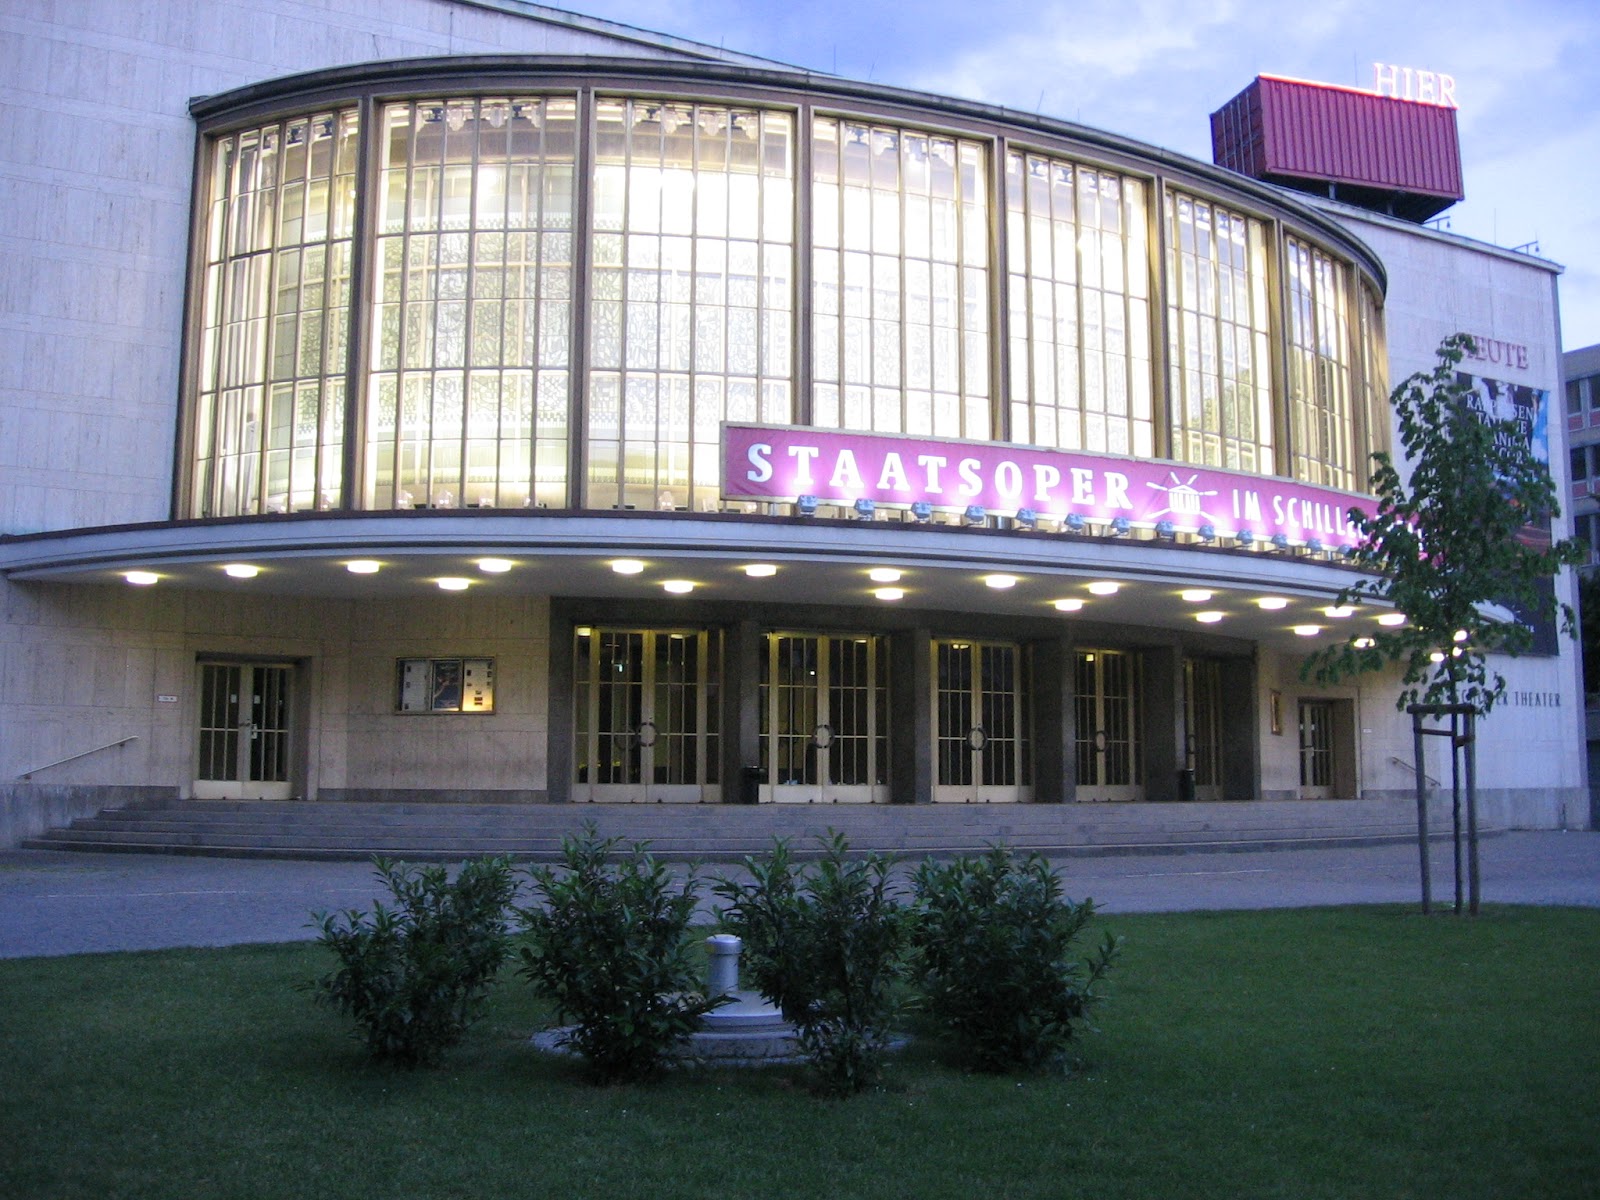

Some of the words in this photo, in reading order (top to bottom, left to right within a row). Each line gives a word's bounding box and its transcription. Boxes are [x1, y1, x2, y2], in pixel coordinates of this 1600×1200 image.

[1373, 62, 1459, 109] HIER
[1461, 335, 1529, 370] EUTE
[747, 443, 1133, 510] STAATSOPER
[1233, 488, 1262, 523] IM
[1514, 691, 1561, 708] THEATER
